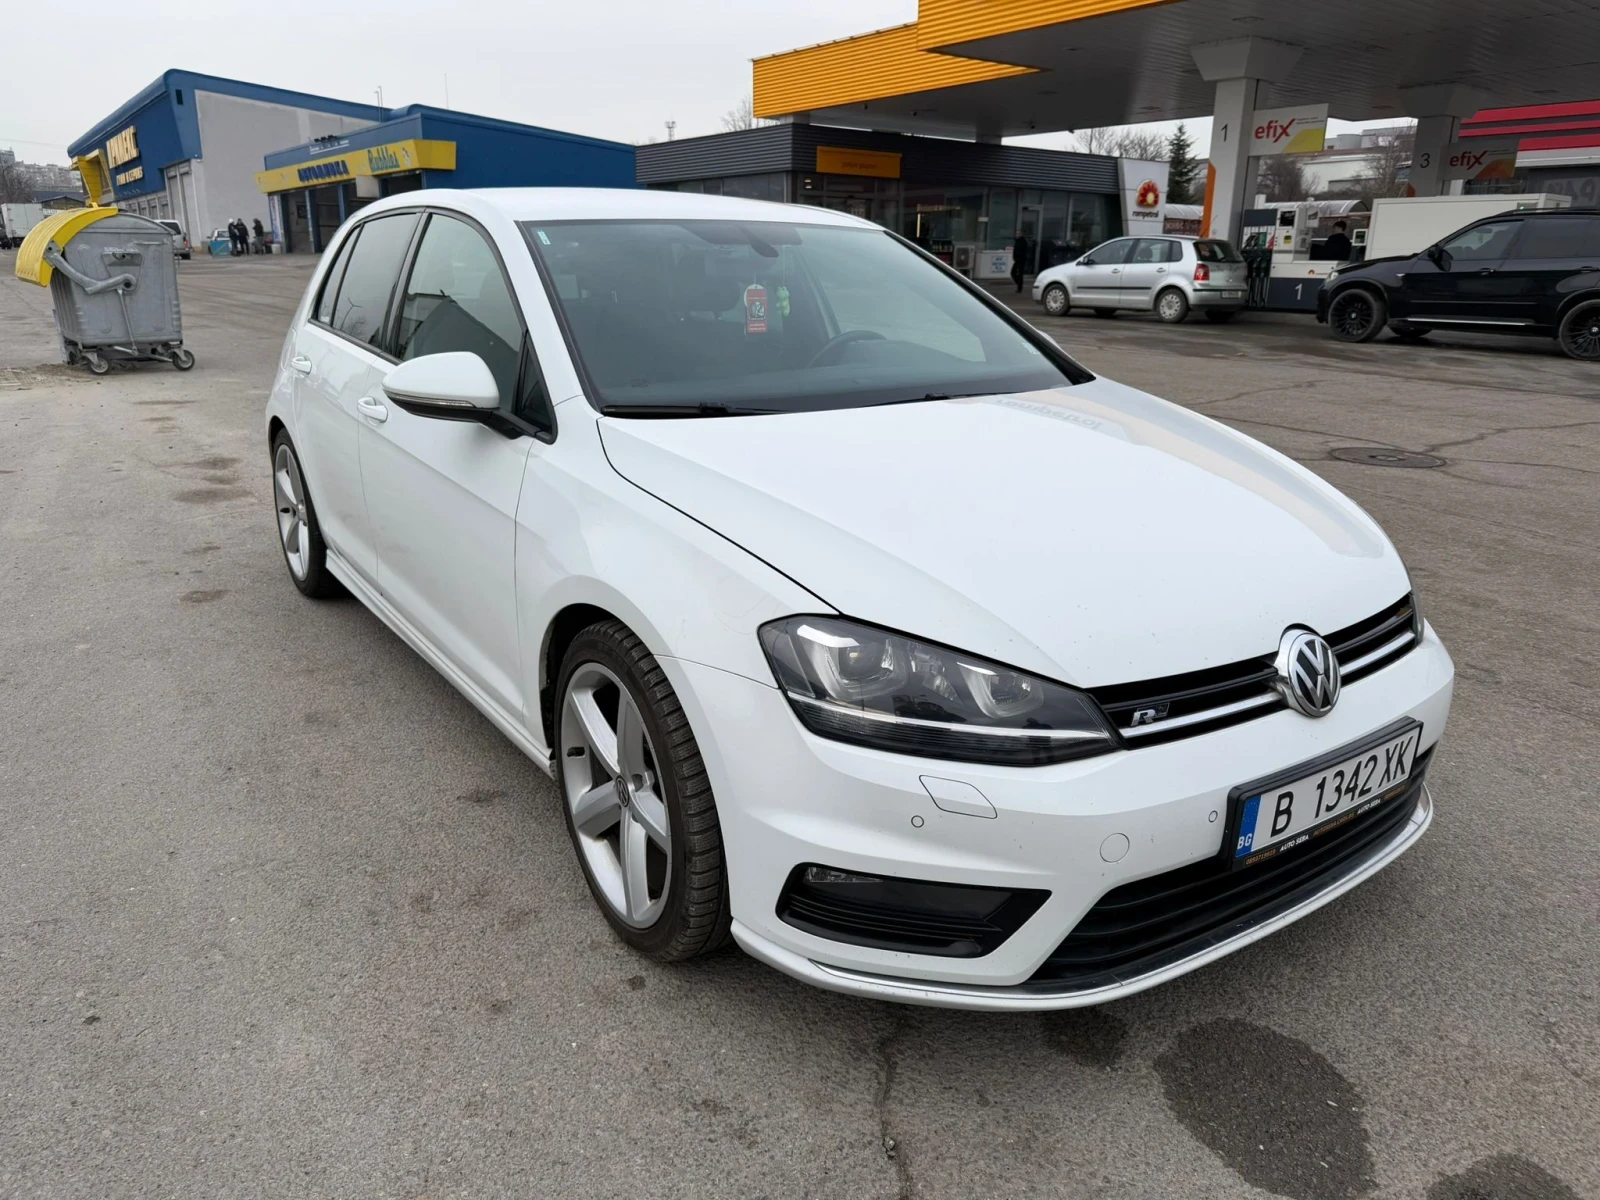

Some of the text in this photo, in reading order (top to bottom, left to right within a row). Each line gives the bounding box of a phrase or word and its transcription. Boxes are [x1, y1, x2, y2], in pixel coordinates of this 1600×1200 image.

[1221, 124, 1228, 142] 1
[1254, 118, 1296, 143] efix
[1420, 153, 1431, 169] 3
[1450, 150, 1488, 170] efix
[1132, 210, 1159, 219] rompetrol
[1295, 283, 1303, 300] 1
[1270, 735, 1413, 838] B 1342 XK
[1237, 832, 1253, 850] BG
[1279, 841, 1296, 852] AUTO
